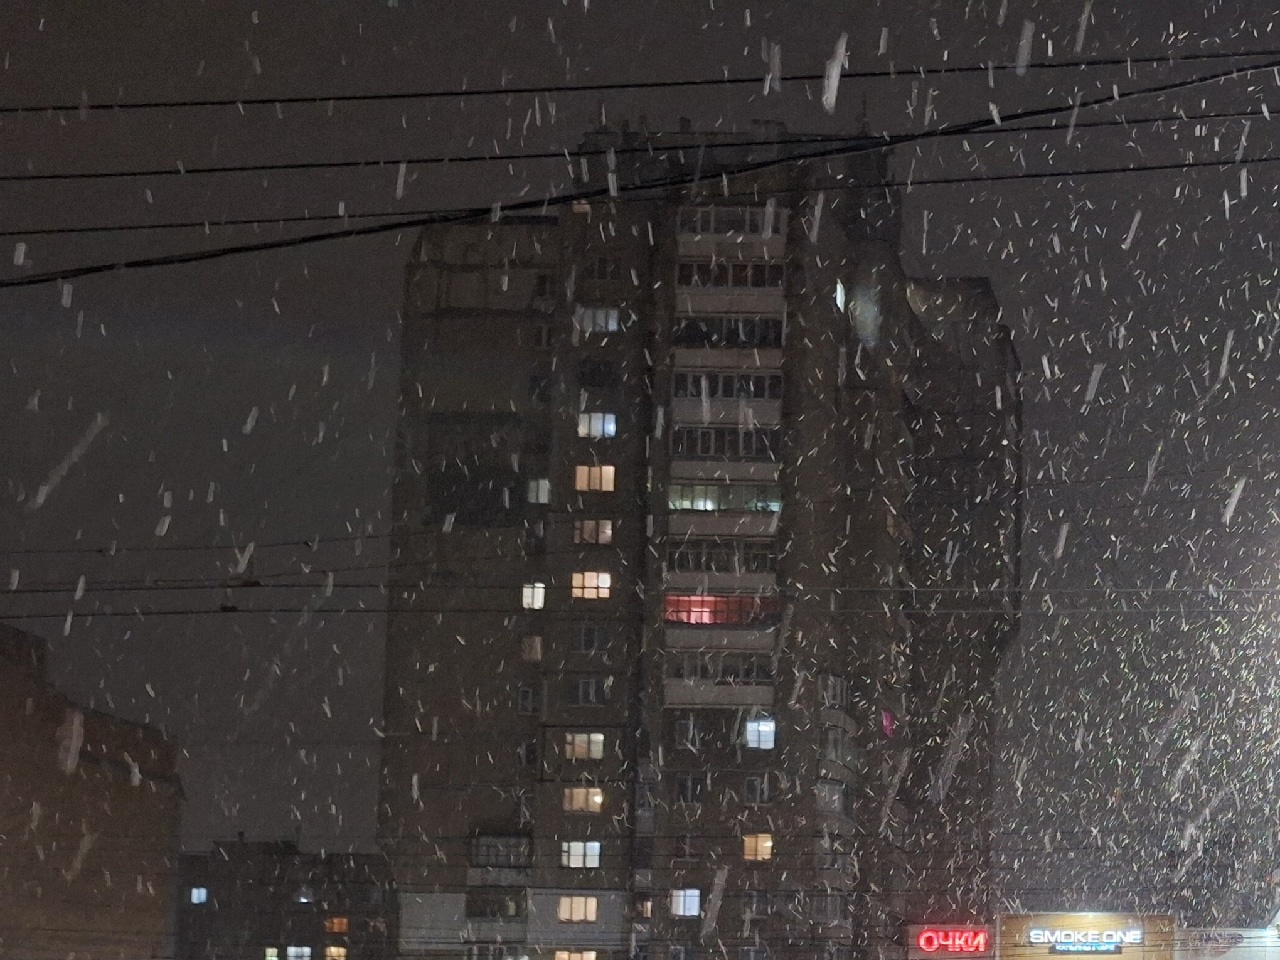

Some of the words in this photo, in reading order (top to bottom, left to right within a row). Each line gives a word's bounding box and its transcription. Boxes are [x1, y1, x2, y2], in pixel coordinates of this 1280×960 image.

[919, 930, 986, 952] ОЧКИ
[1029, 929, 1097, 943] SMOKE
[1102, 929, 1142, 943] ONE
